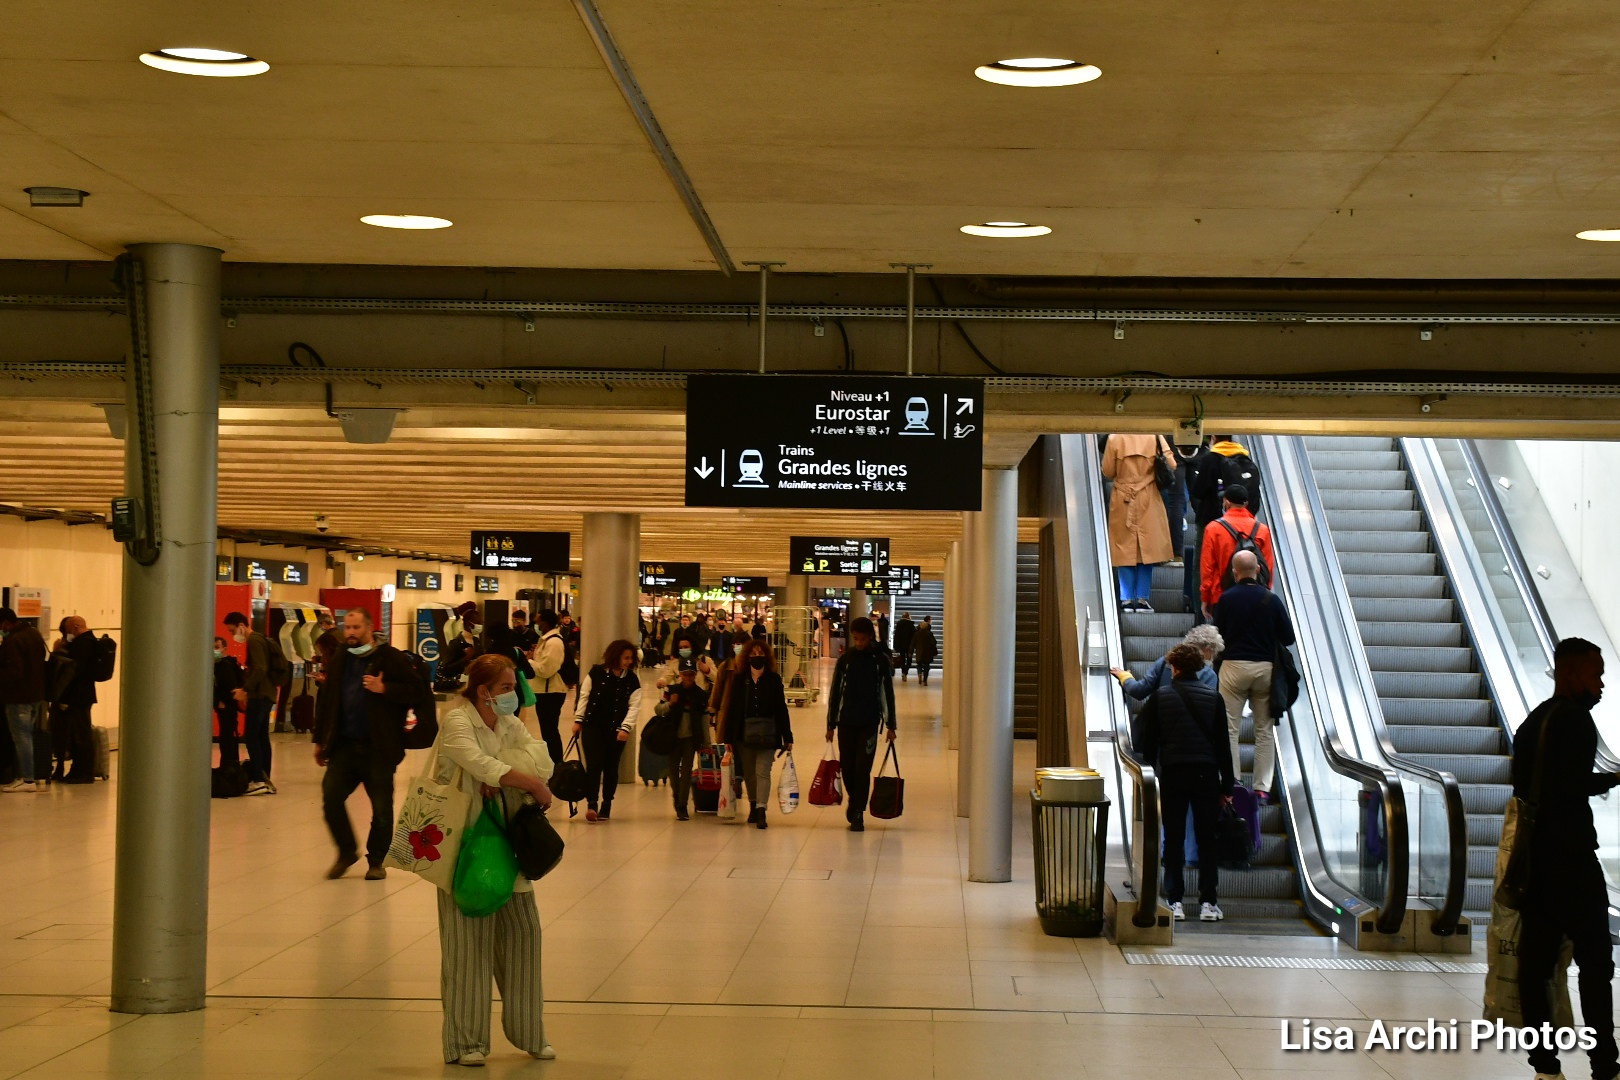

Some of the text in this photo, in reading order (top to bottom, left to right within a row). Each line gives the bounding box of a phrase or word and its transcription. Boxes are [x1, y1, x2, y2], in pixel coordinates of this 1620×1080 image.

[830, 390, 890, 403] Niveau +1
[815, 404, 891, 421] Eurostar
[810, 425, 890, 436] +1 Level 等级 +1
[778, 445, 815, 456] Trains
[778, 459, 908, 480] Grandes lignes
[778, 480, 907, 492] Mainline services 干线火车
[703, 588, 734, 606] city
